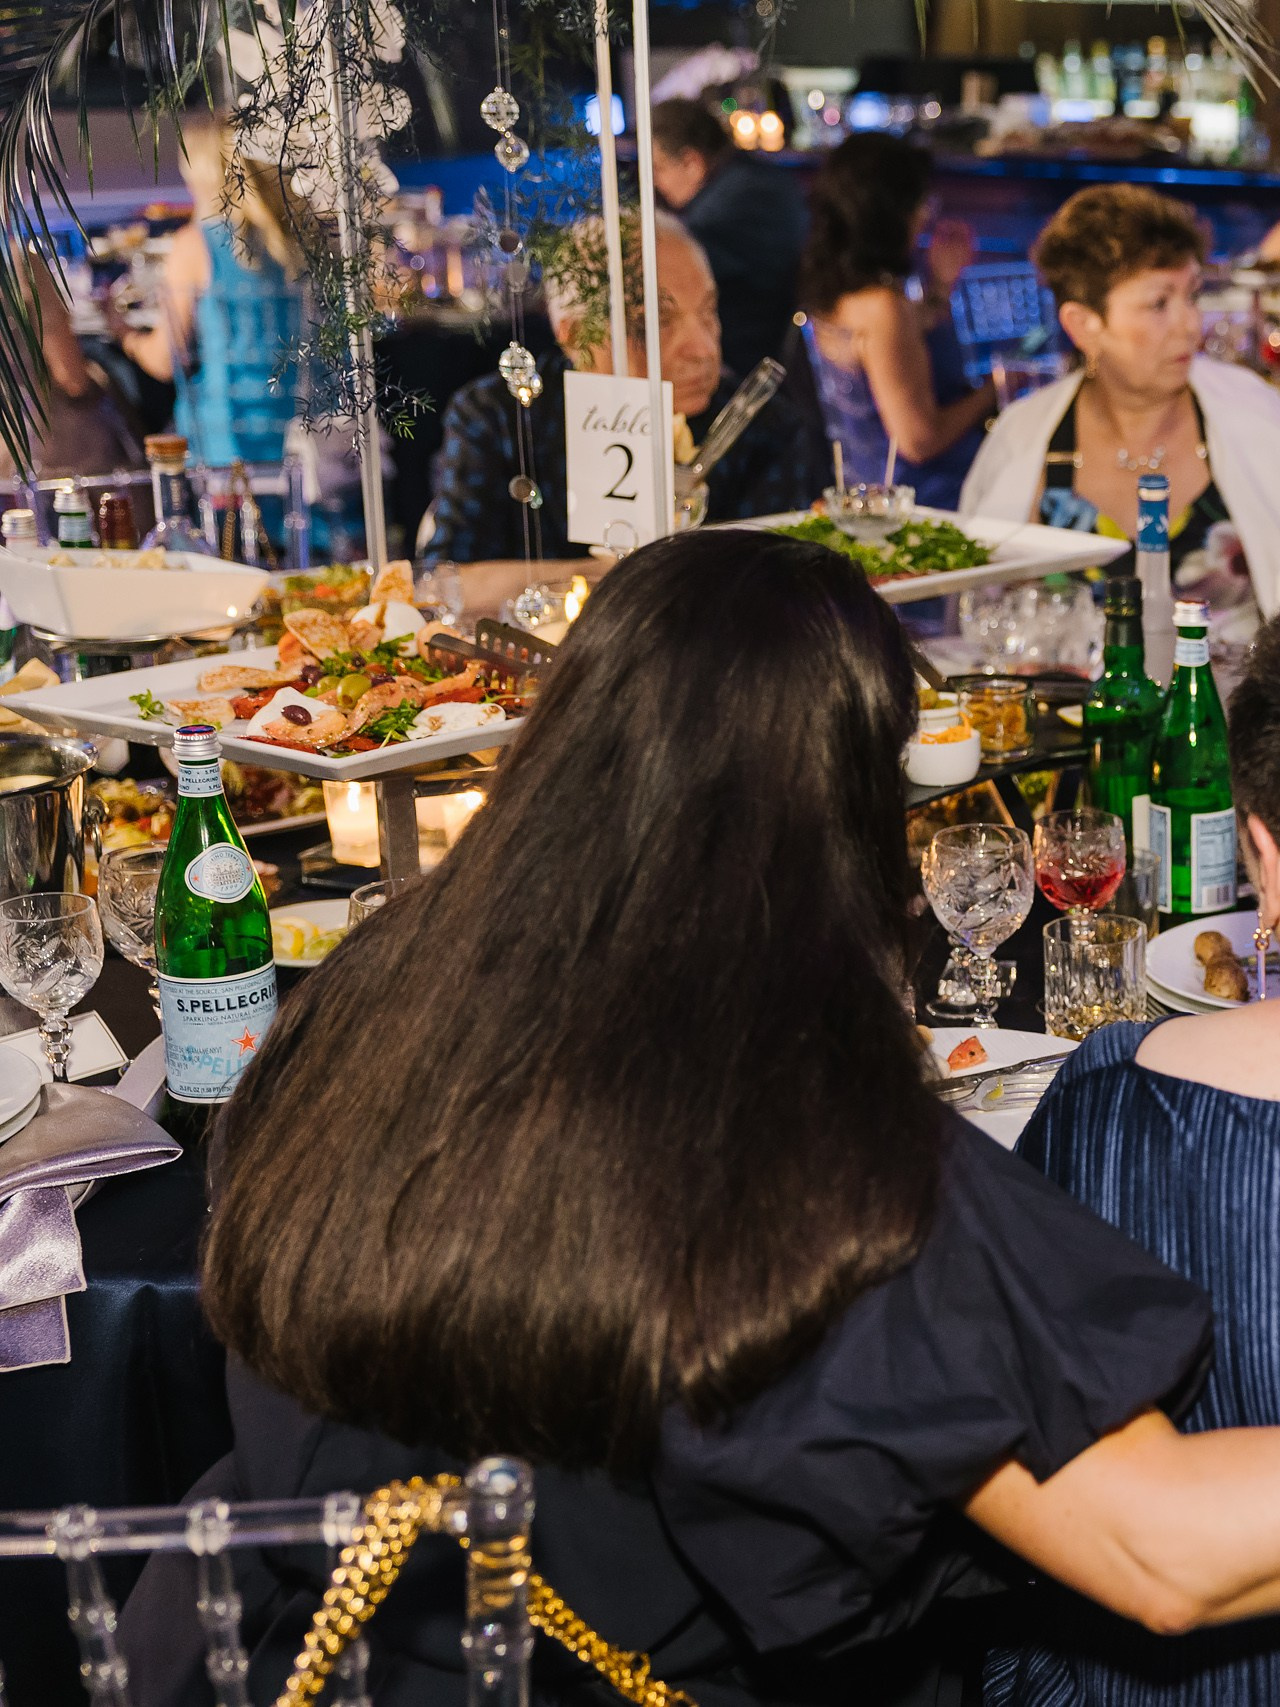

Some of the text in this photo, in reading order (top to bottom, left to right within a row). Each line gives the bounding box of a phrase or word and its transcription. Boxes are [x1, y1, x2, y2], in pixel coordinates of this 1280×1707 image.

[581, 402, 652, 438] table
[602, 443, 638, 502] 2
[182, 1015, 219, 1023] SPARKLING
[220, 1011, 251, 1021] NATURAL
